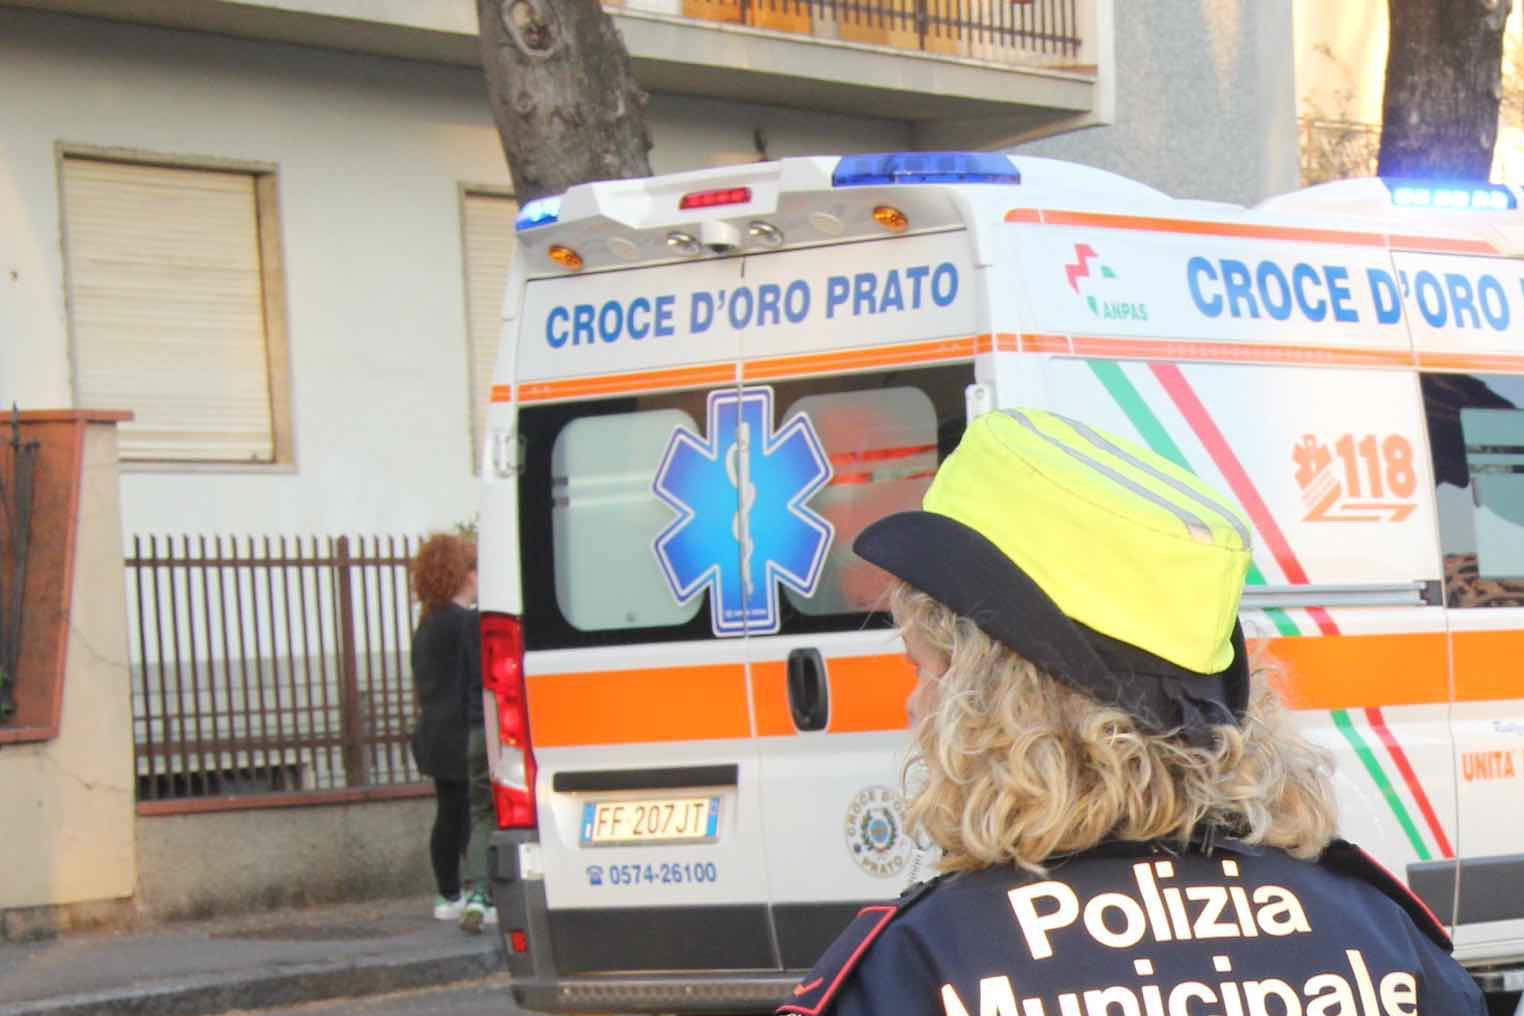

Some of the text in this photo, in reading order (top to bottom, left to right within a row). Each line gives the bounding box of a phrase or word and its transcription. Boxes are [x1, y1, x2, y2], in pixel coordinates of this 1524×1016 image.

[546, 262, 960, 349] CROCE D'ORO PRATO
[1186, 257, 1359, 324] CROCE
[1366, 268, 1509, 331] D'ORO
[1334, 433, 1417, 499] 118
[608, 861, 718, 885] 0574-26100
[1007, 859, 1312, 961] Polizia
